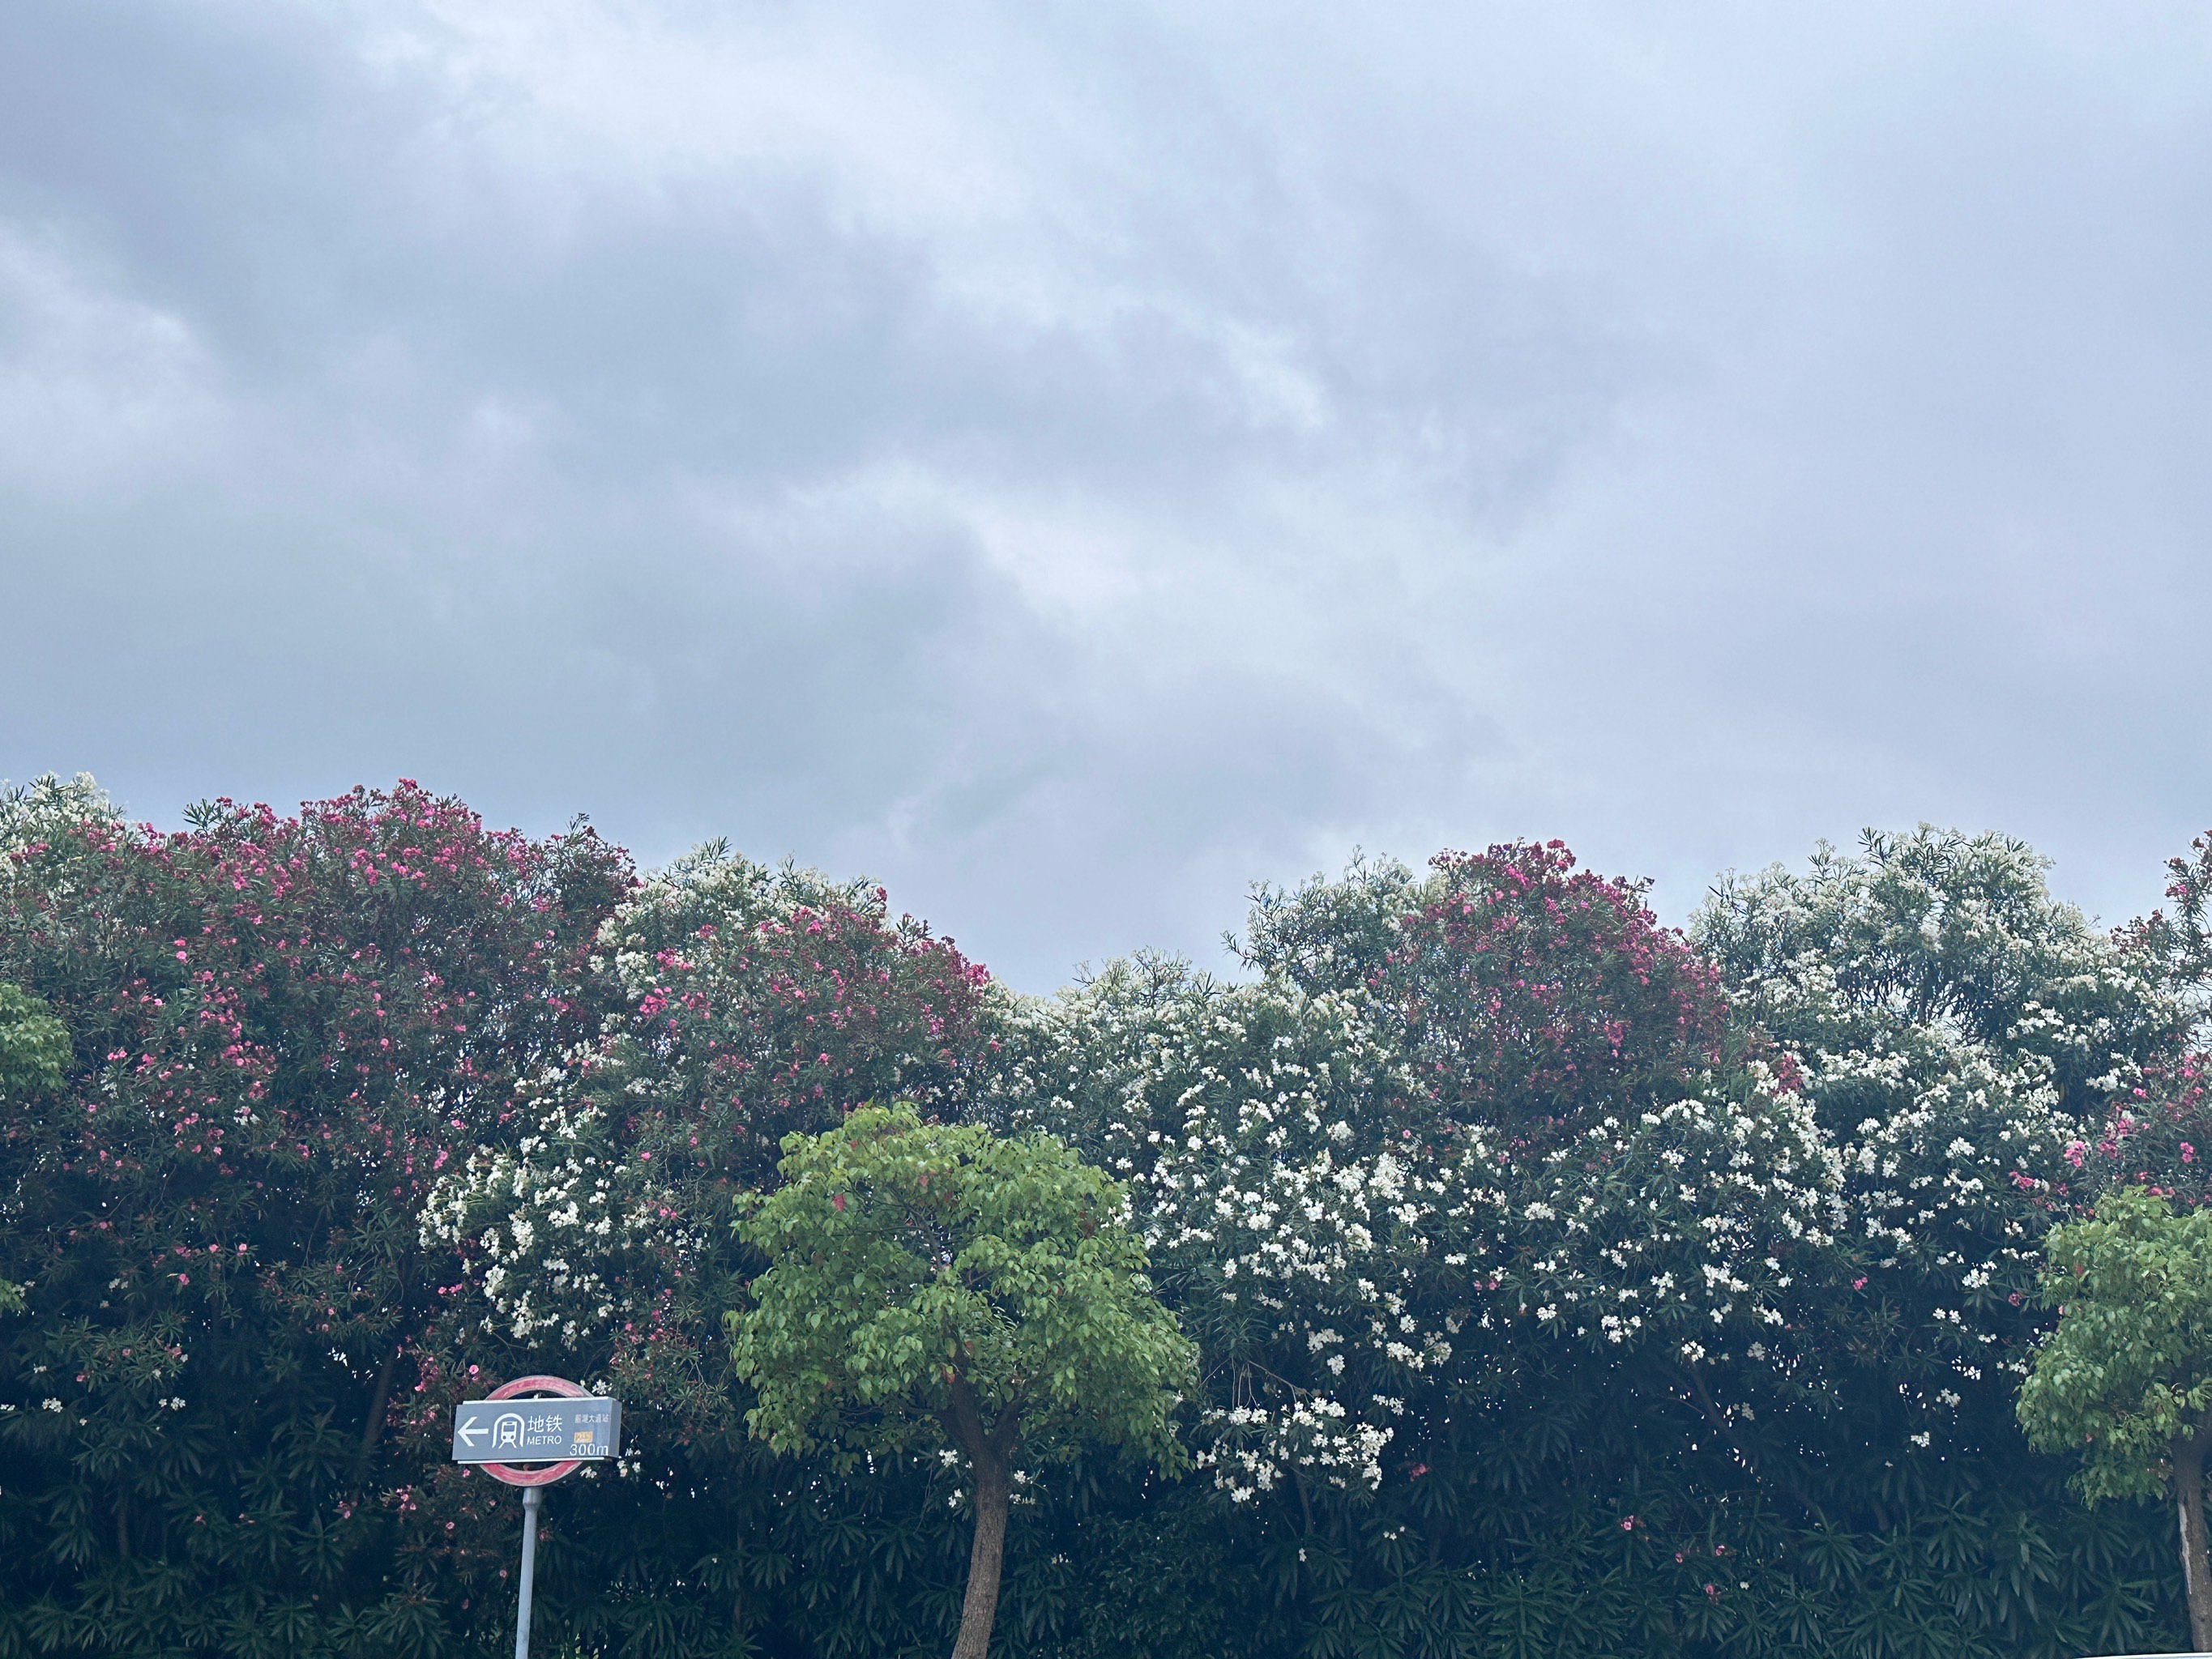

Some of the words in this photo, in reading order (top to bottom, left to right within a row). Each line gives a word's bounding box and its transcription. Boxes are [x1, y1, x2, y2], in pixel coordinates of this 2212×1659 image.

[527, 1414, 562, 1433] 地铁
[527, 1435, 562, 1445] METRO
[569, 1444, 609, 1456] 300m
